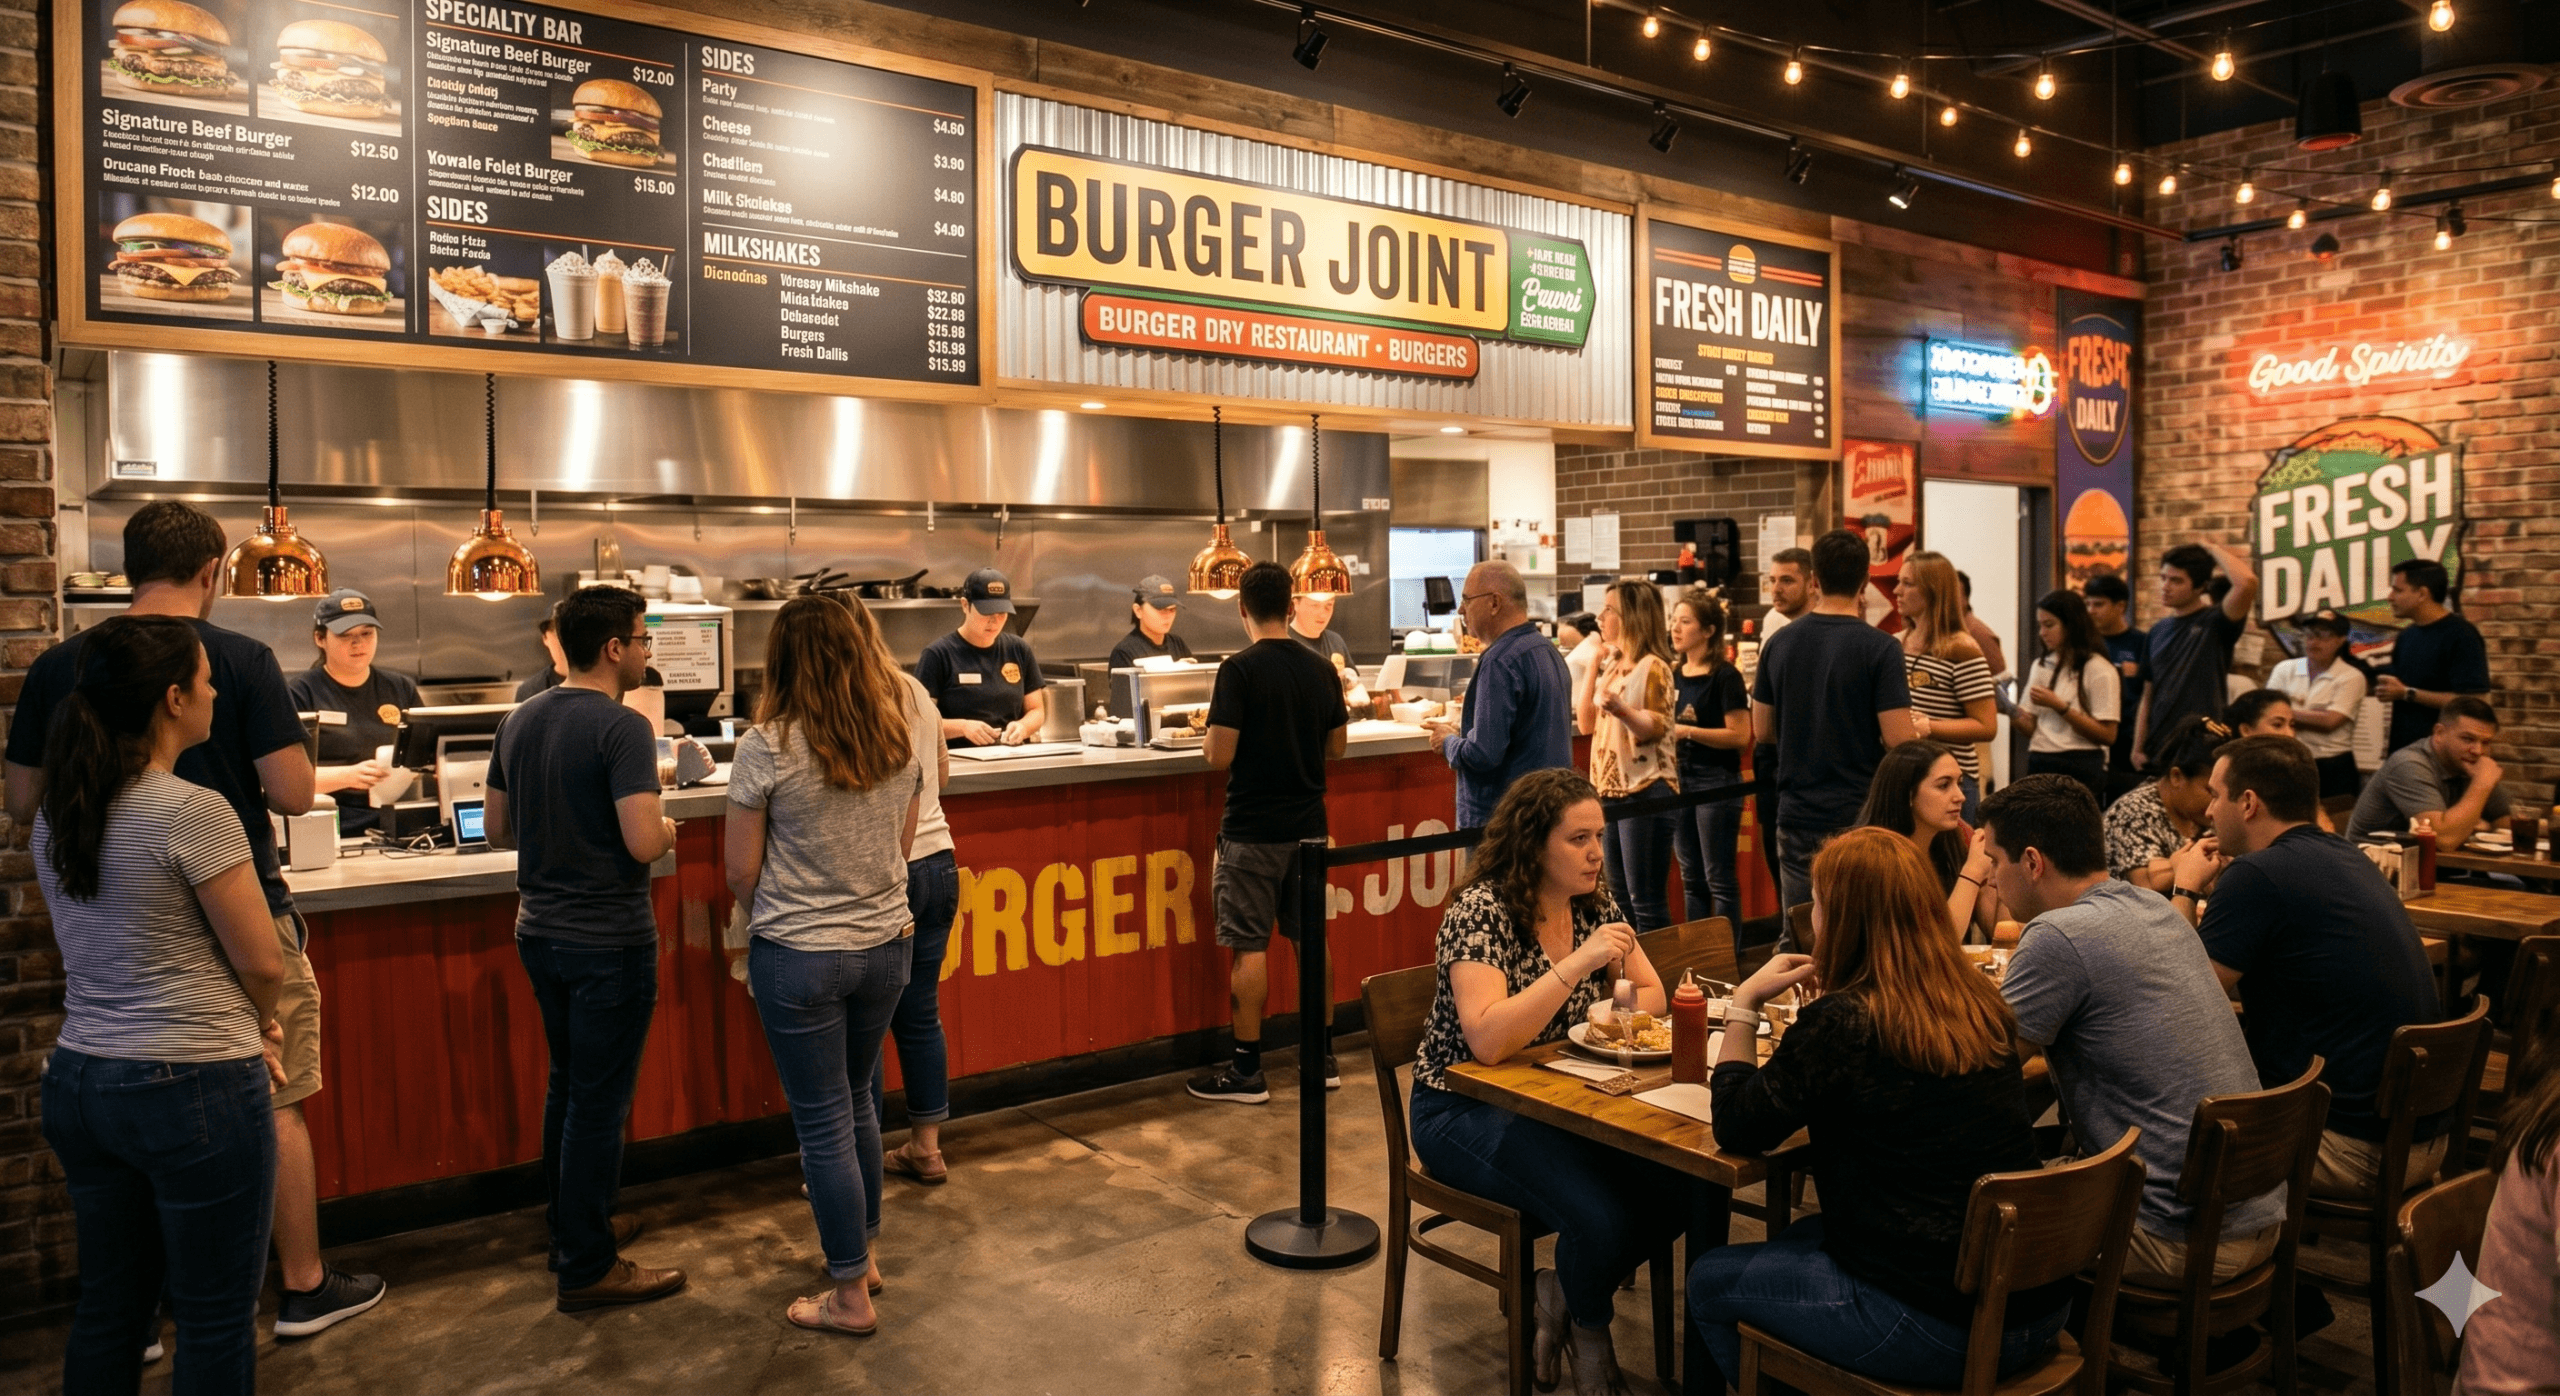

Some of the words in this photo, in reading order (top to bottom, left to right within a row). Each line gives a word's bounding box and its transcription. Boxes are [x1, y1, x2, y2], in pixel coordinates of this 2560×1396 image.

[426, 0, 537, 36] SPECIALTY
[543, 17, 583, 45] BAR
[426, 31, 500, 58] Signature
[504, 44, 540, 64] Beef
[542, 51, 592, 75] Burger
[702, 46, 755, 75] SIDES
[633, 66, 674, 86] $12.00
[702, 77, 738, 100] Party
[102, 108, 188, 134] Signature
[192, 119, 232, 140] Beef
[235, 125, 292, 149] Burger
[702, 114, 752, 136] Cheese
[350, 140, 399, 160] $12.50
[525, 163, 573, 184] Burger
[351, 183, 399, 203] $12.00
[427, 195, 488, 224] SIDES
[703, 189, 734, 207] Milk
[703, 232, 821, 267] MILKSHAKES
[1036, 170, 1307, 289] BURGER
[1328, 221, 1495, 312] JOINT
[1655, 276, 1743, 337] FRESH
[1751, 292, 1823, 347] DAILY
[780, 325, 825, 344] Burgers
[781, 343, 814, 359] Fresh
[1099, 305, 1197, 341] BURGER
[1205, 317, 1244, 345] DRY
[1250, 324, 1369, 360] RESTAURANT
[1388, 338, 1468, 369] BURGERS
[2068, 335, 2132, 389] FRESH
[2248, 346, 2339, 393] Good
[2344, 333, 2470, 385] Spirits
[2076, 397, 2118, 432] DAILY
[2259, 452, 2452, 556] FRESH
[2262, 522, 2454, 622] DAILY
